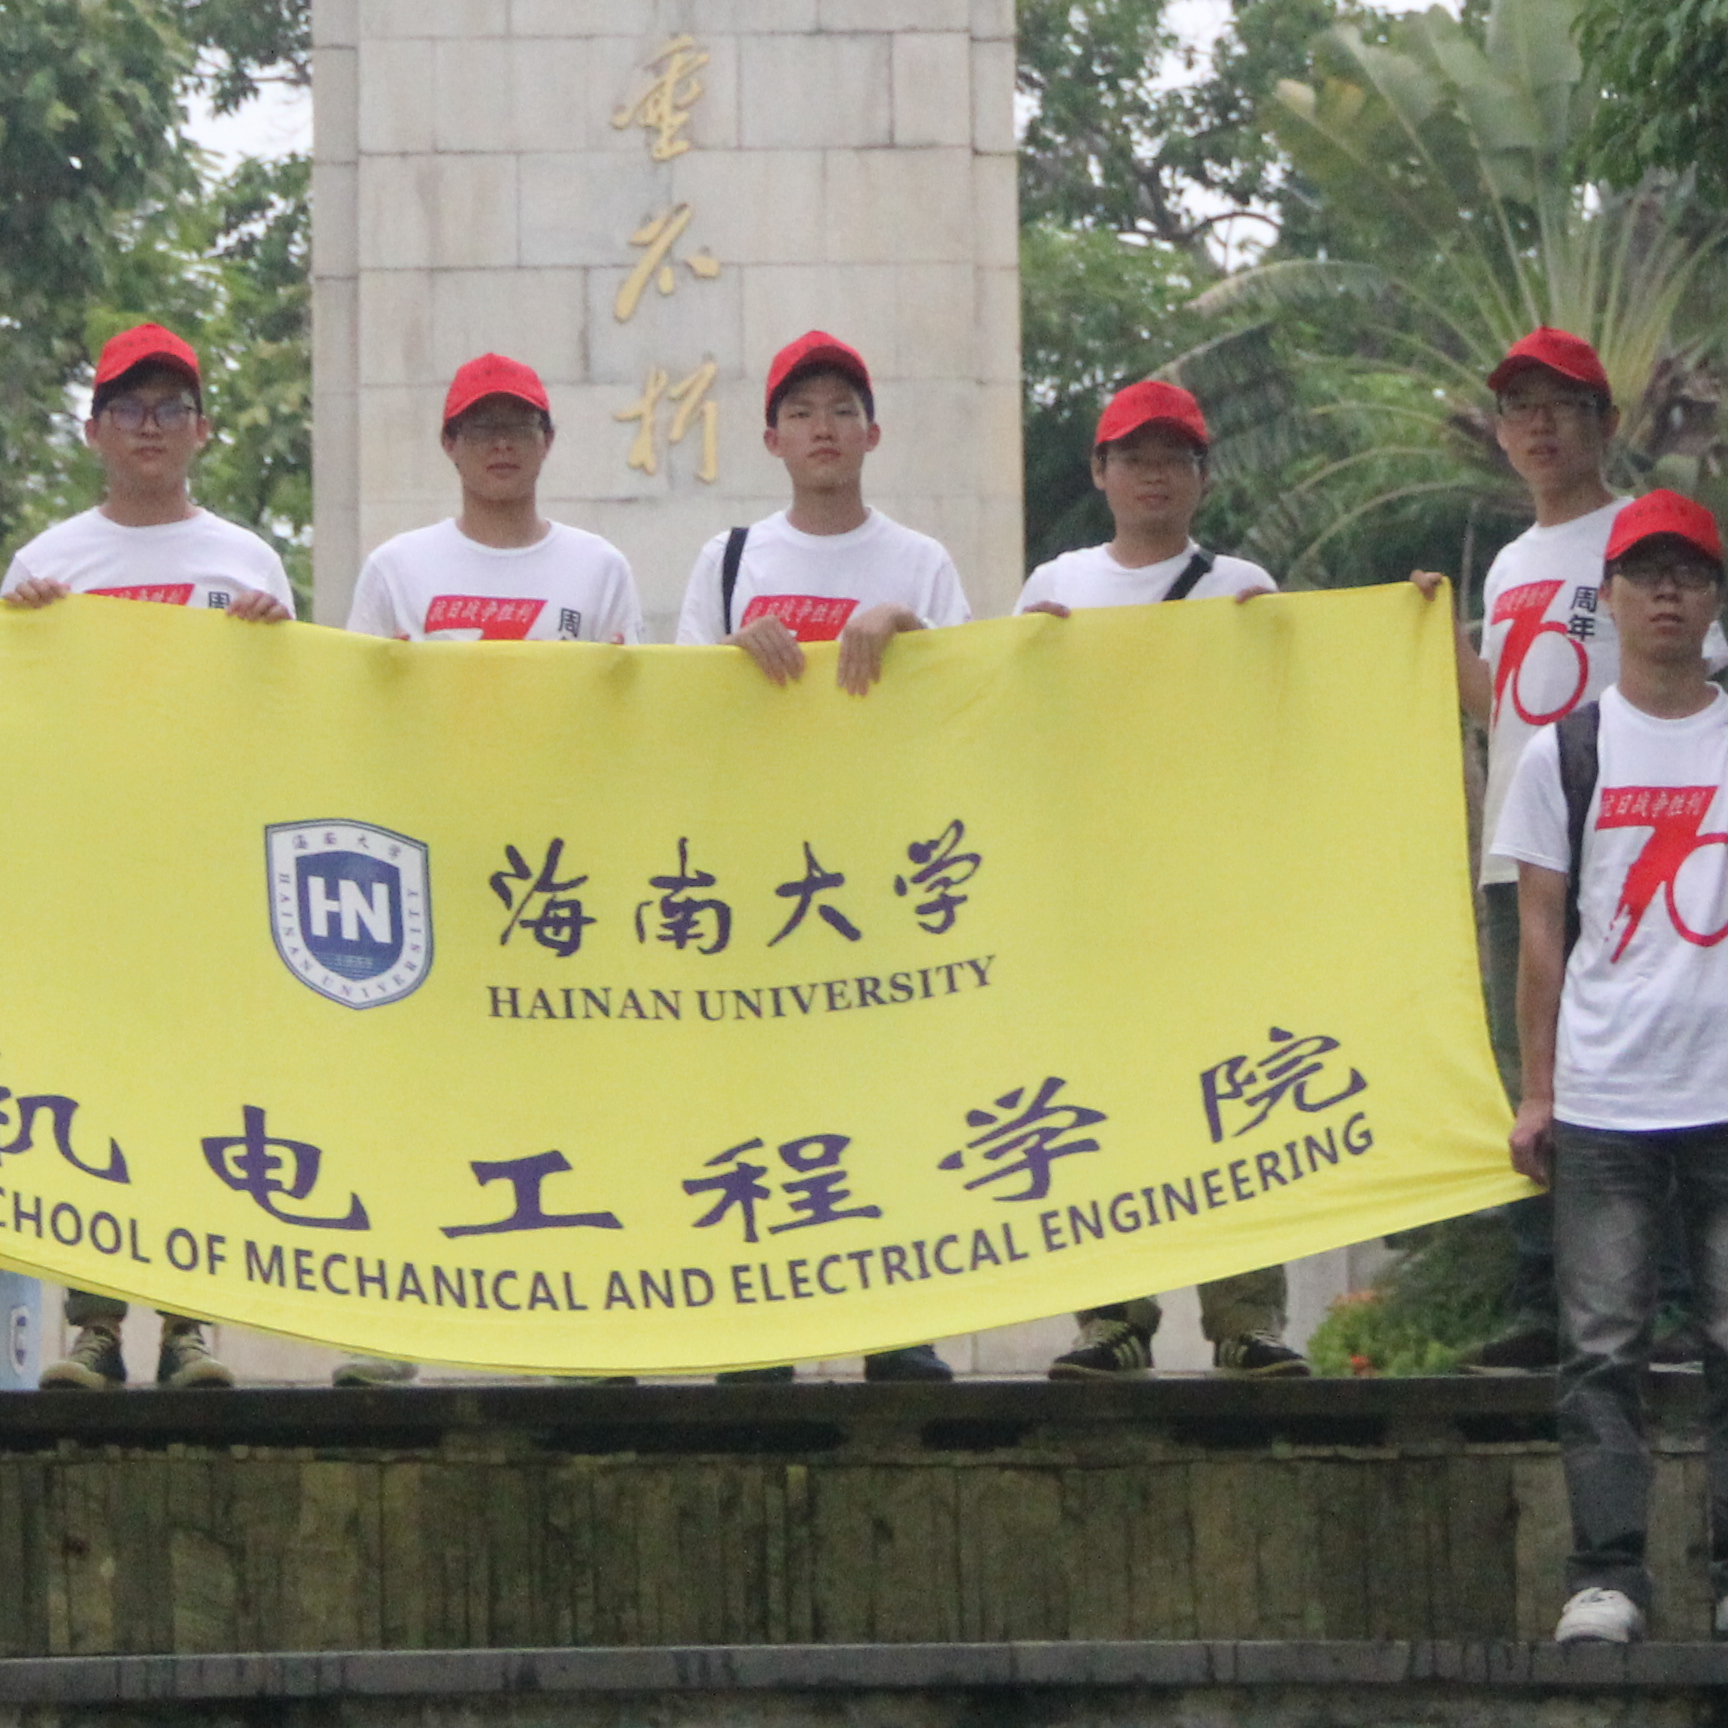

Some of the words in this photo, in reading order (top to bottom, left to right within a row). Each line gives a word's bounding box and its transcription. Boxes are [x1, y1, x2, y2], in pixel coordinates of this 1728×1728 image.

[1569, 585, 1599, 643] 周年
[489, 819, 982, 958] 海南大学
[486, 986, 681, 1020] HAINAN
[695, 955, 996, 1021] UNIVERSITY
[166, 1228, 226, 1275] OF
[245, 1240, 589, 1311] MECHANICAL
[603, 1268, 715, 1310] AND
[731, 1222, 1029, 1304] ELECTRICAL
[1040, 1112, 1374, 1252] ENGINEERING
